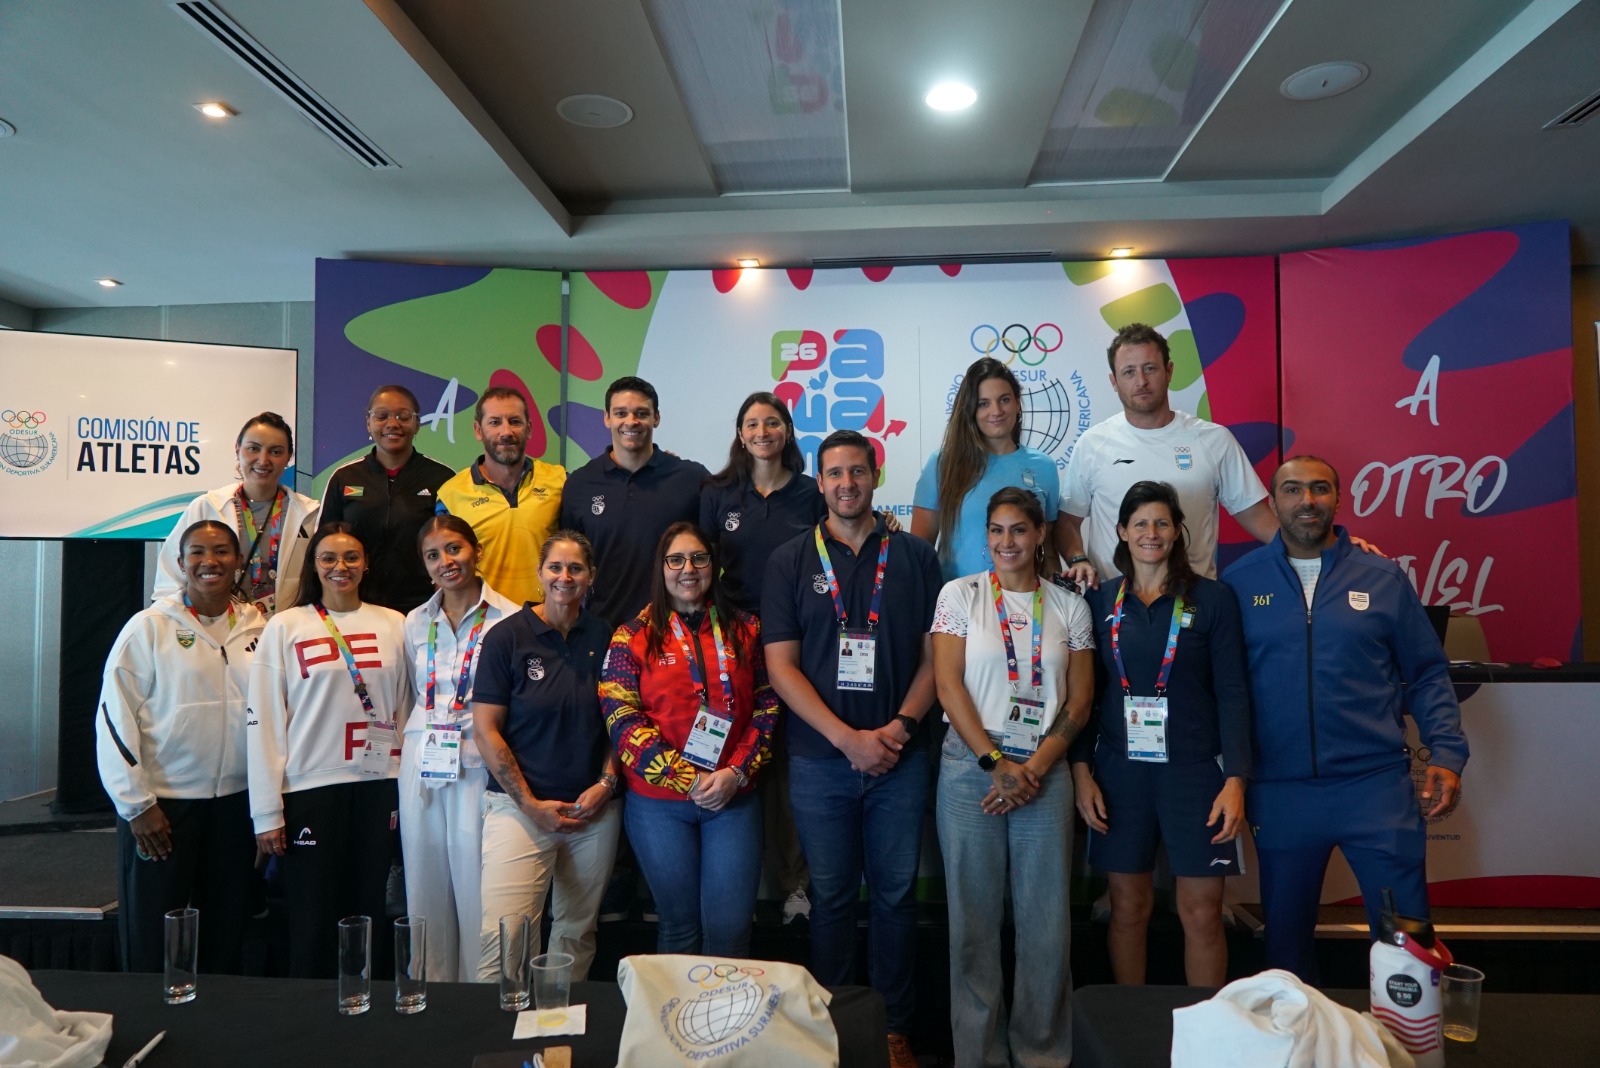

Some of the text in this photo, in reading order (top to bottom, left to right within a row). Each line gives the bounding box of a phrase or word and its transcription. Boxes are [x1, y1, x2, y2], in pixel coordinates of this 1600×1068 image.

[780, 342, 818, 362] 26
[1395, 354, 1440, 426] A
[420, 377, 459, 444] A
[77, 416, 200, 443] COMISIÓN DE
[77, 441, 201, 475] ATLETAS
[1350, 454, 1508, 519] OTRO
[699, 982, 748, 999] ODESUR
[686, 1036, 750, 1061] DEPORTIVA
